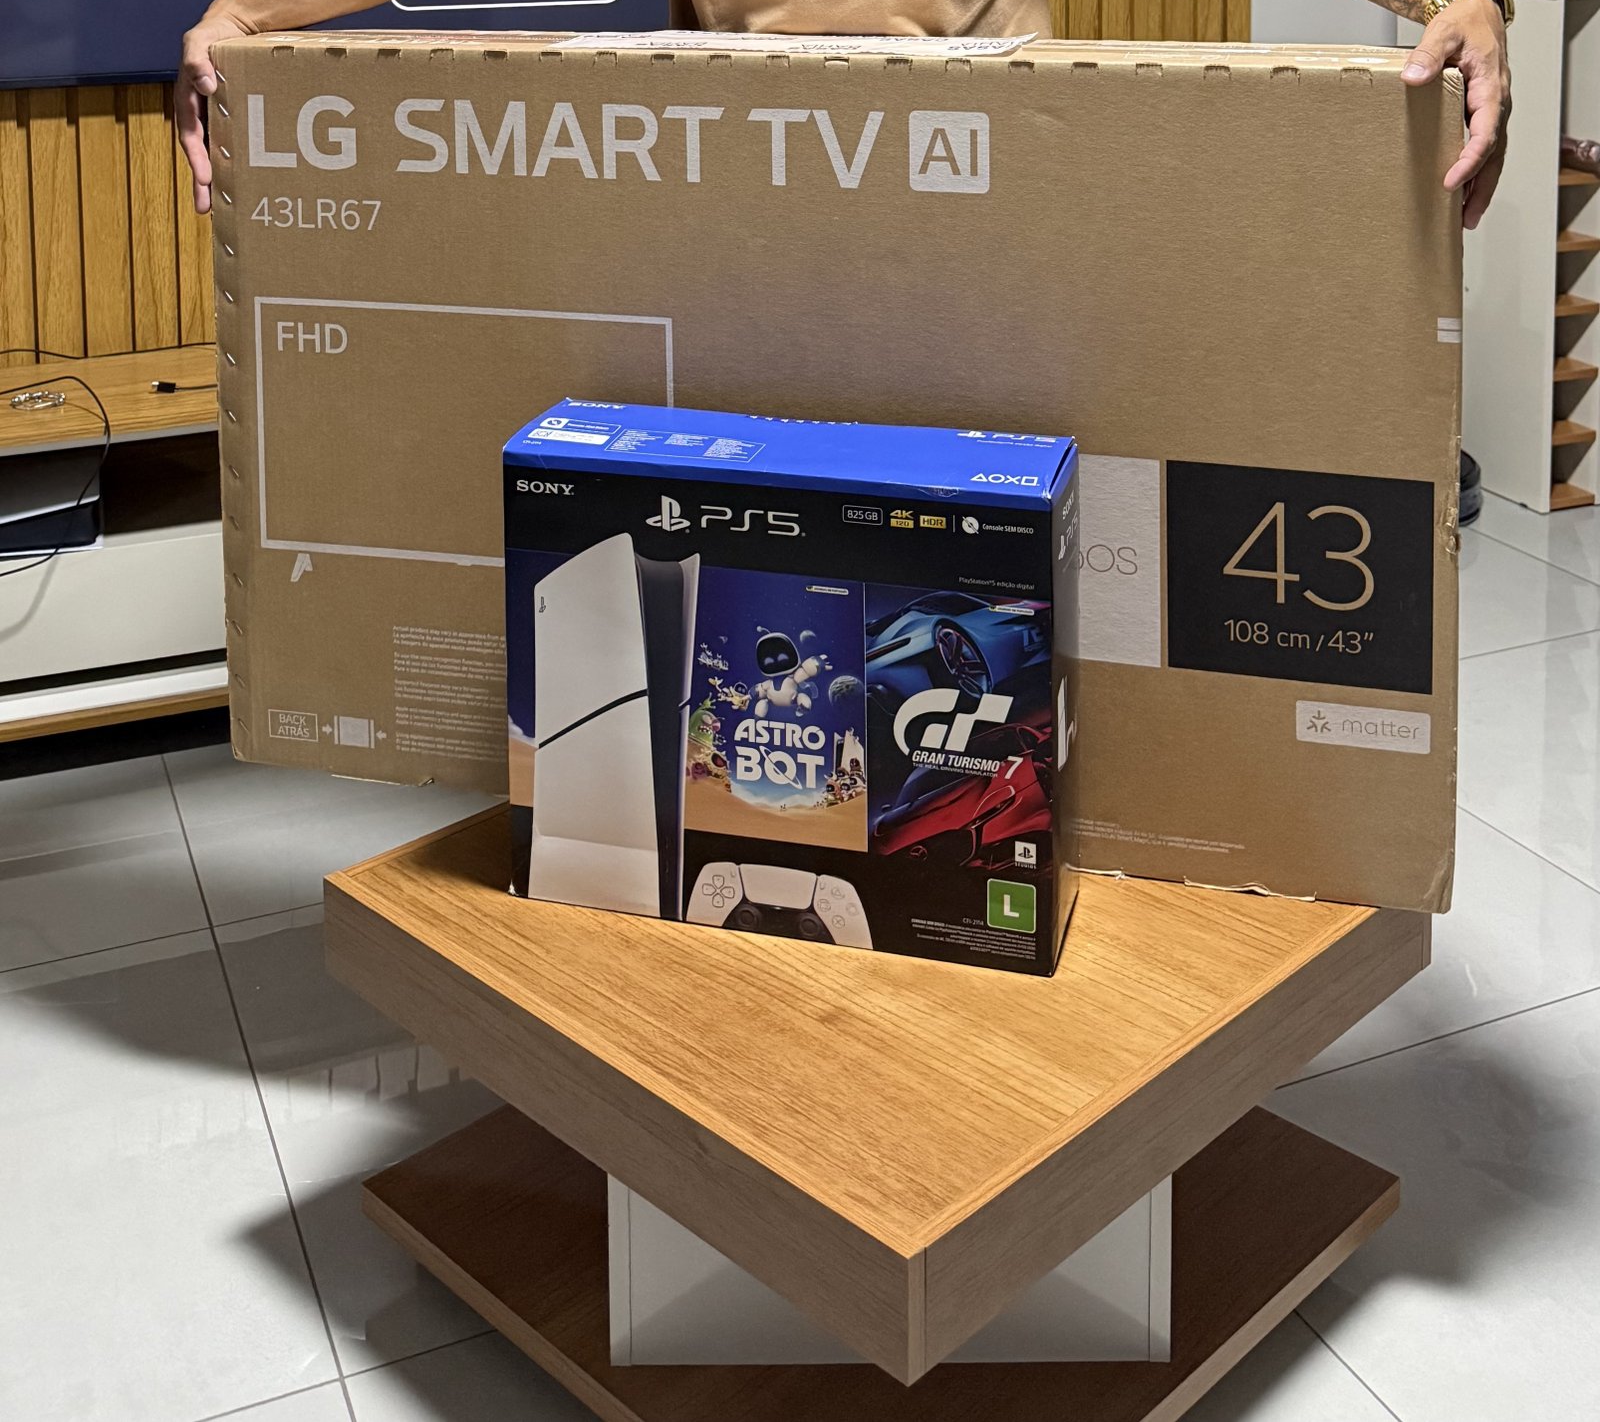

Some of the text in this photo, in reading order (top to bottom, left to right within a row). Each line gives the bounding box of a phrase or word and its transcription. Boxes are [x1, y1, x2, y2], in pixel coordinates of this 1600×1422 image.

[247, 94, 979, 189] LG SMART TV AI
[250, 196, 382, 231] 43LR67
[276, 321, 348, 354] FHD
[516, 480, 574, 495] SONY
[700, 505, 801, 537] PS5
[847, 509, 879, 521] 825 GB
[889, 509, 914, 519] 4K
[922, 518, 944, 527] HDR
[1017, 526, 1034, 534] DISCO
[1223, 501, 1375, 611] 43
[1224, 619, 1269, 645] 108
[1277, 631, 1310, 649] cm
[278, 724, 310, 738] ATRÁS
[279, 713, 306, 726] BACK
[1342, 718, 1420, 739] matter
[734, 718, 826, 750] ASTRO
[735, 745, 825, 789] BOT
[912, 750, 1024, 779] GRAN TURISMO 7
[1003, 894, 1020, 918] L
